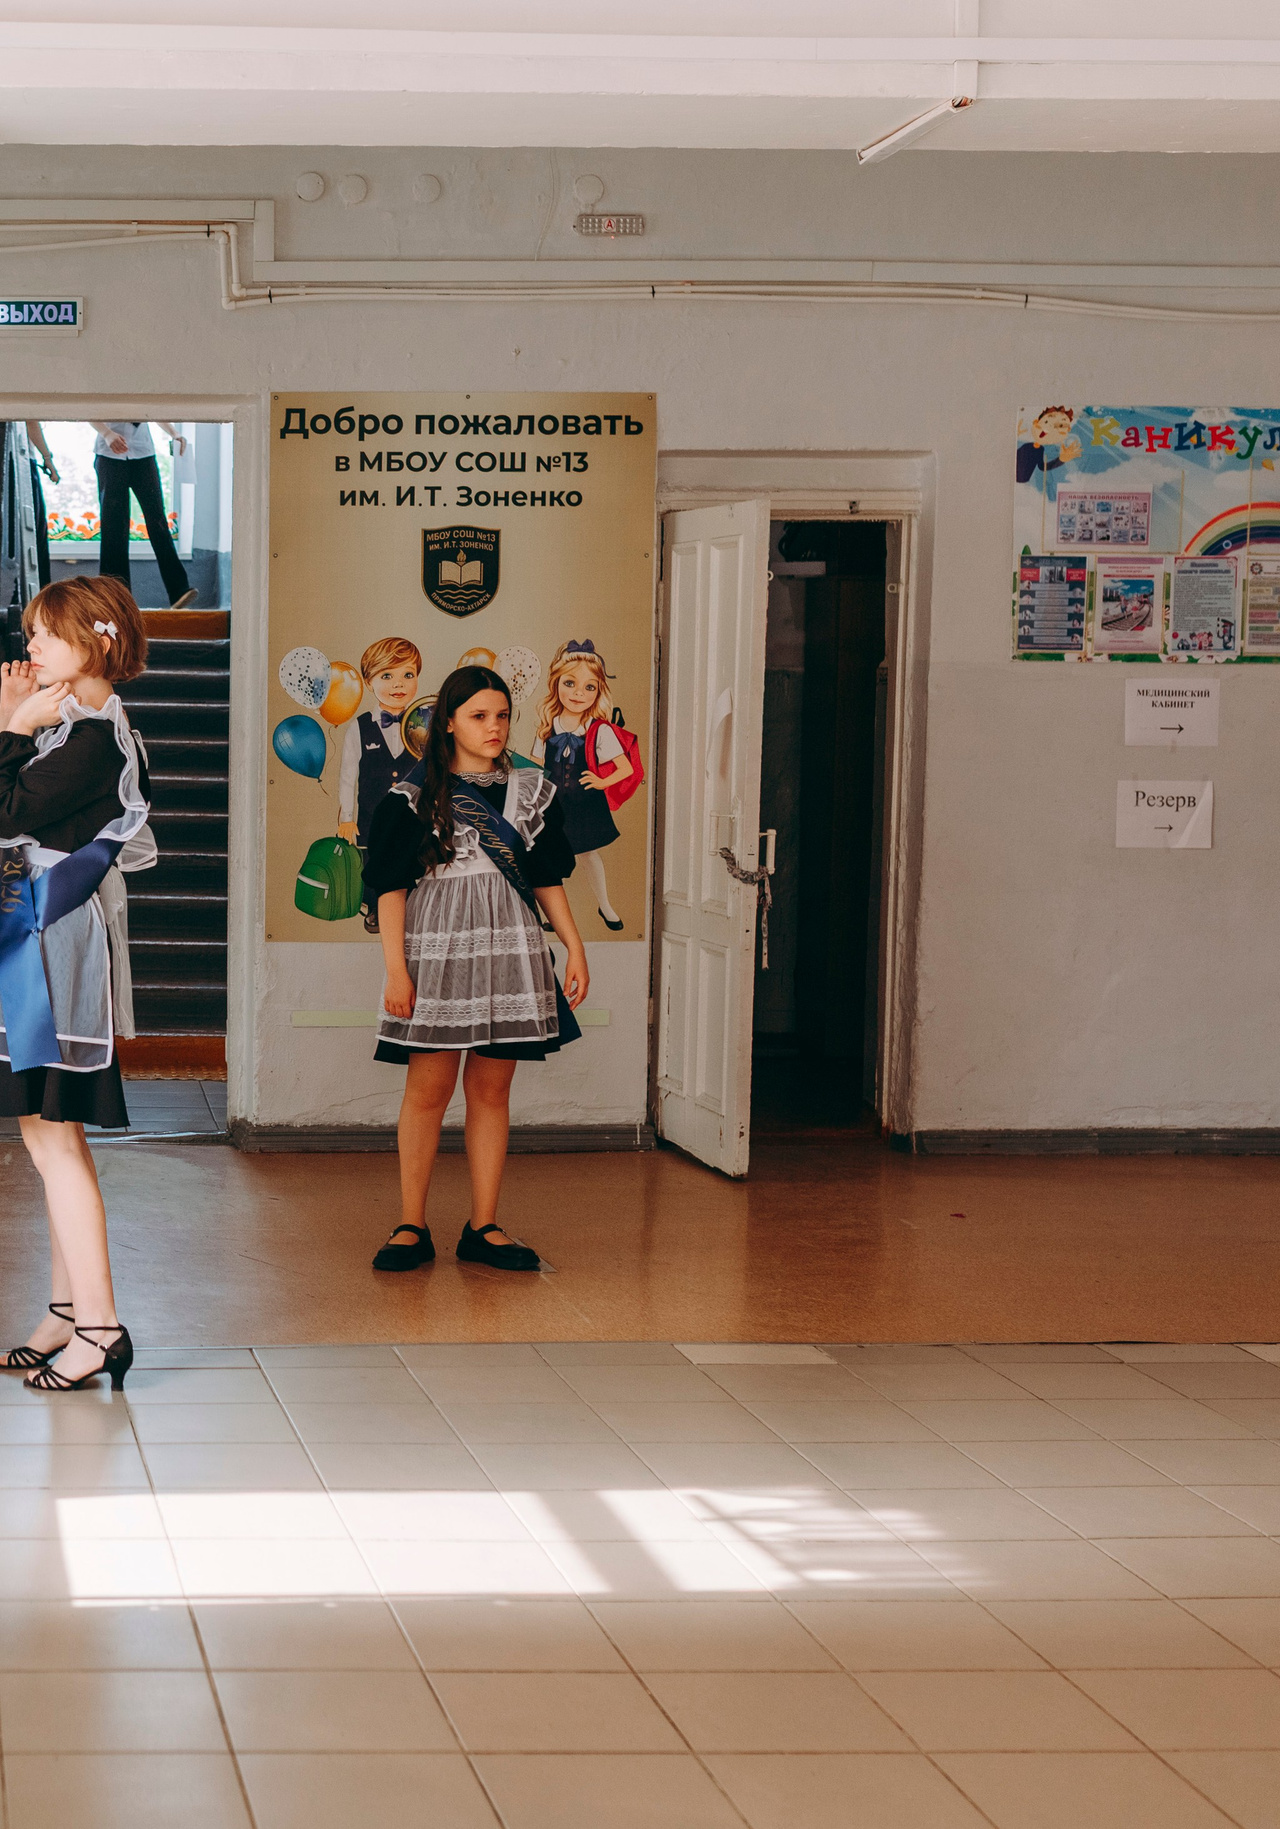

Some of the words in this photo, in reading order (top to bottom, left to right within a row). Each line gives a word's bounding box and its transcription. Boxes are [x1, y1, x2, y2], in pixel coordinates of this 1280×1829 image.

[280, 406, 404, 441] Добро
[415, 413, 644, 436] пожаловать
[334, 456, 350, 472] в
[360, 451, 447, 473] МБОУ
[455, 451, 526, 473] СОШ
[536, 451, 589, 473] №13
[339, 489, 386, 506] им.
[396, 486, 447, 507] И.Т.
[456, 486, 583, 507] Зоненко
[426, 530, 451, 542] МБОУ
[452, 530, 474, 539] СОШ
[477, 532, 496, 542] №13
[460, 540, 494, 551] ЗОНЕНКО
[1136, 688, 1210, 698] МЕДИЦИНСКИЙ
[1151, 701, 1196, 709] КАБИНЕТ
[1134, 790, 1197, 812] Резерв
[0, 858, 26, 913] 2026
